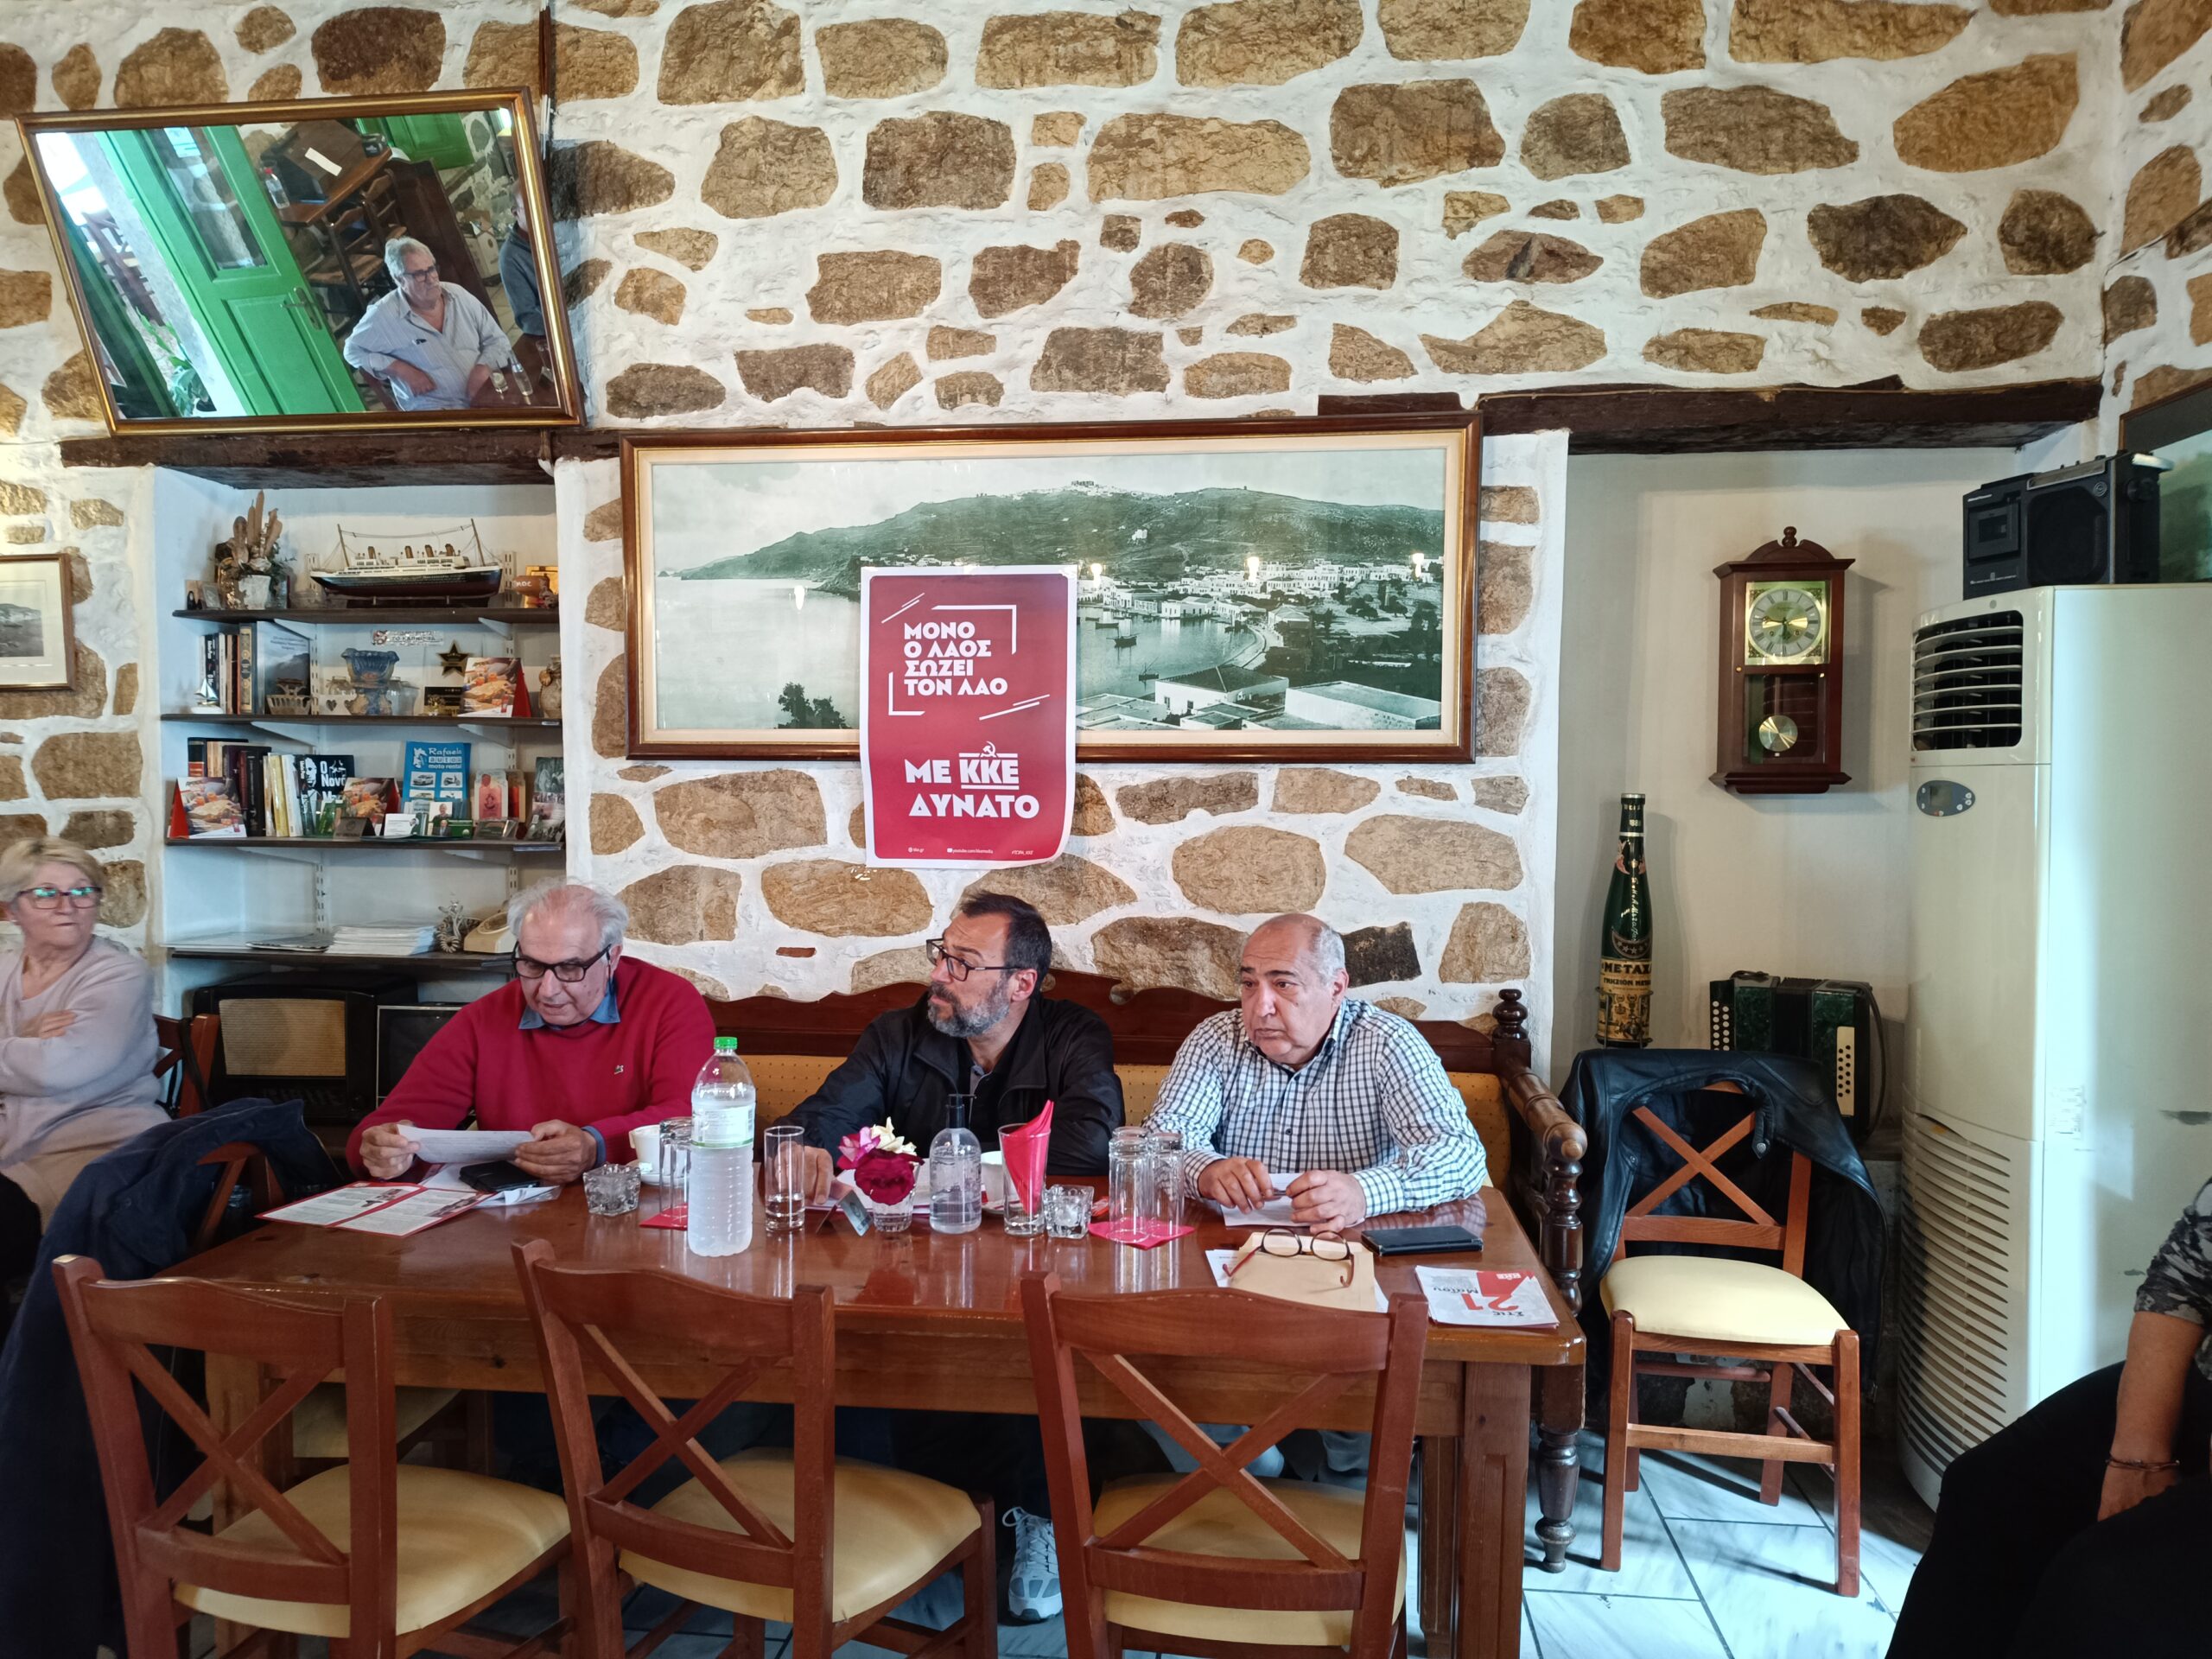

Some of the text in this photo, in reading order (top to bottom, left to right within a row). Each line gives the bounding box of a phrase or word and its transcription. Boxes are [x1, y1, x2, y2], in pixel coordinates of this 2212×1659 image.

[904, 621, 976, 640] ΜΟΝΟ
[904, 639, 992, 658] Ο ΛΑΟΣ
[904, 659, 974, 677] ΣΩΖΕΙ
[904, 677, 1008, 696] ΤΟΝ ΛΑΟ
[905, 759, 1020, 785] ΜΕ ΚΚΕ
[909, 794, 1039, 819] ΔΥΝΑΤΟ
[1461, 1294, 1519, 1312] 21
